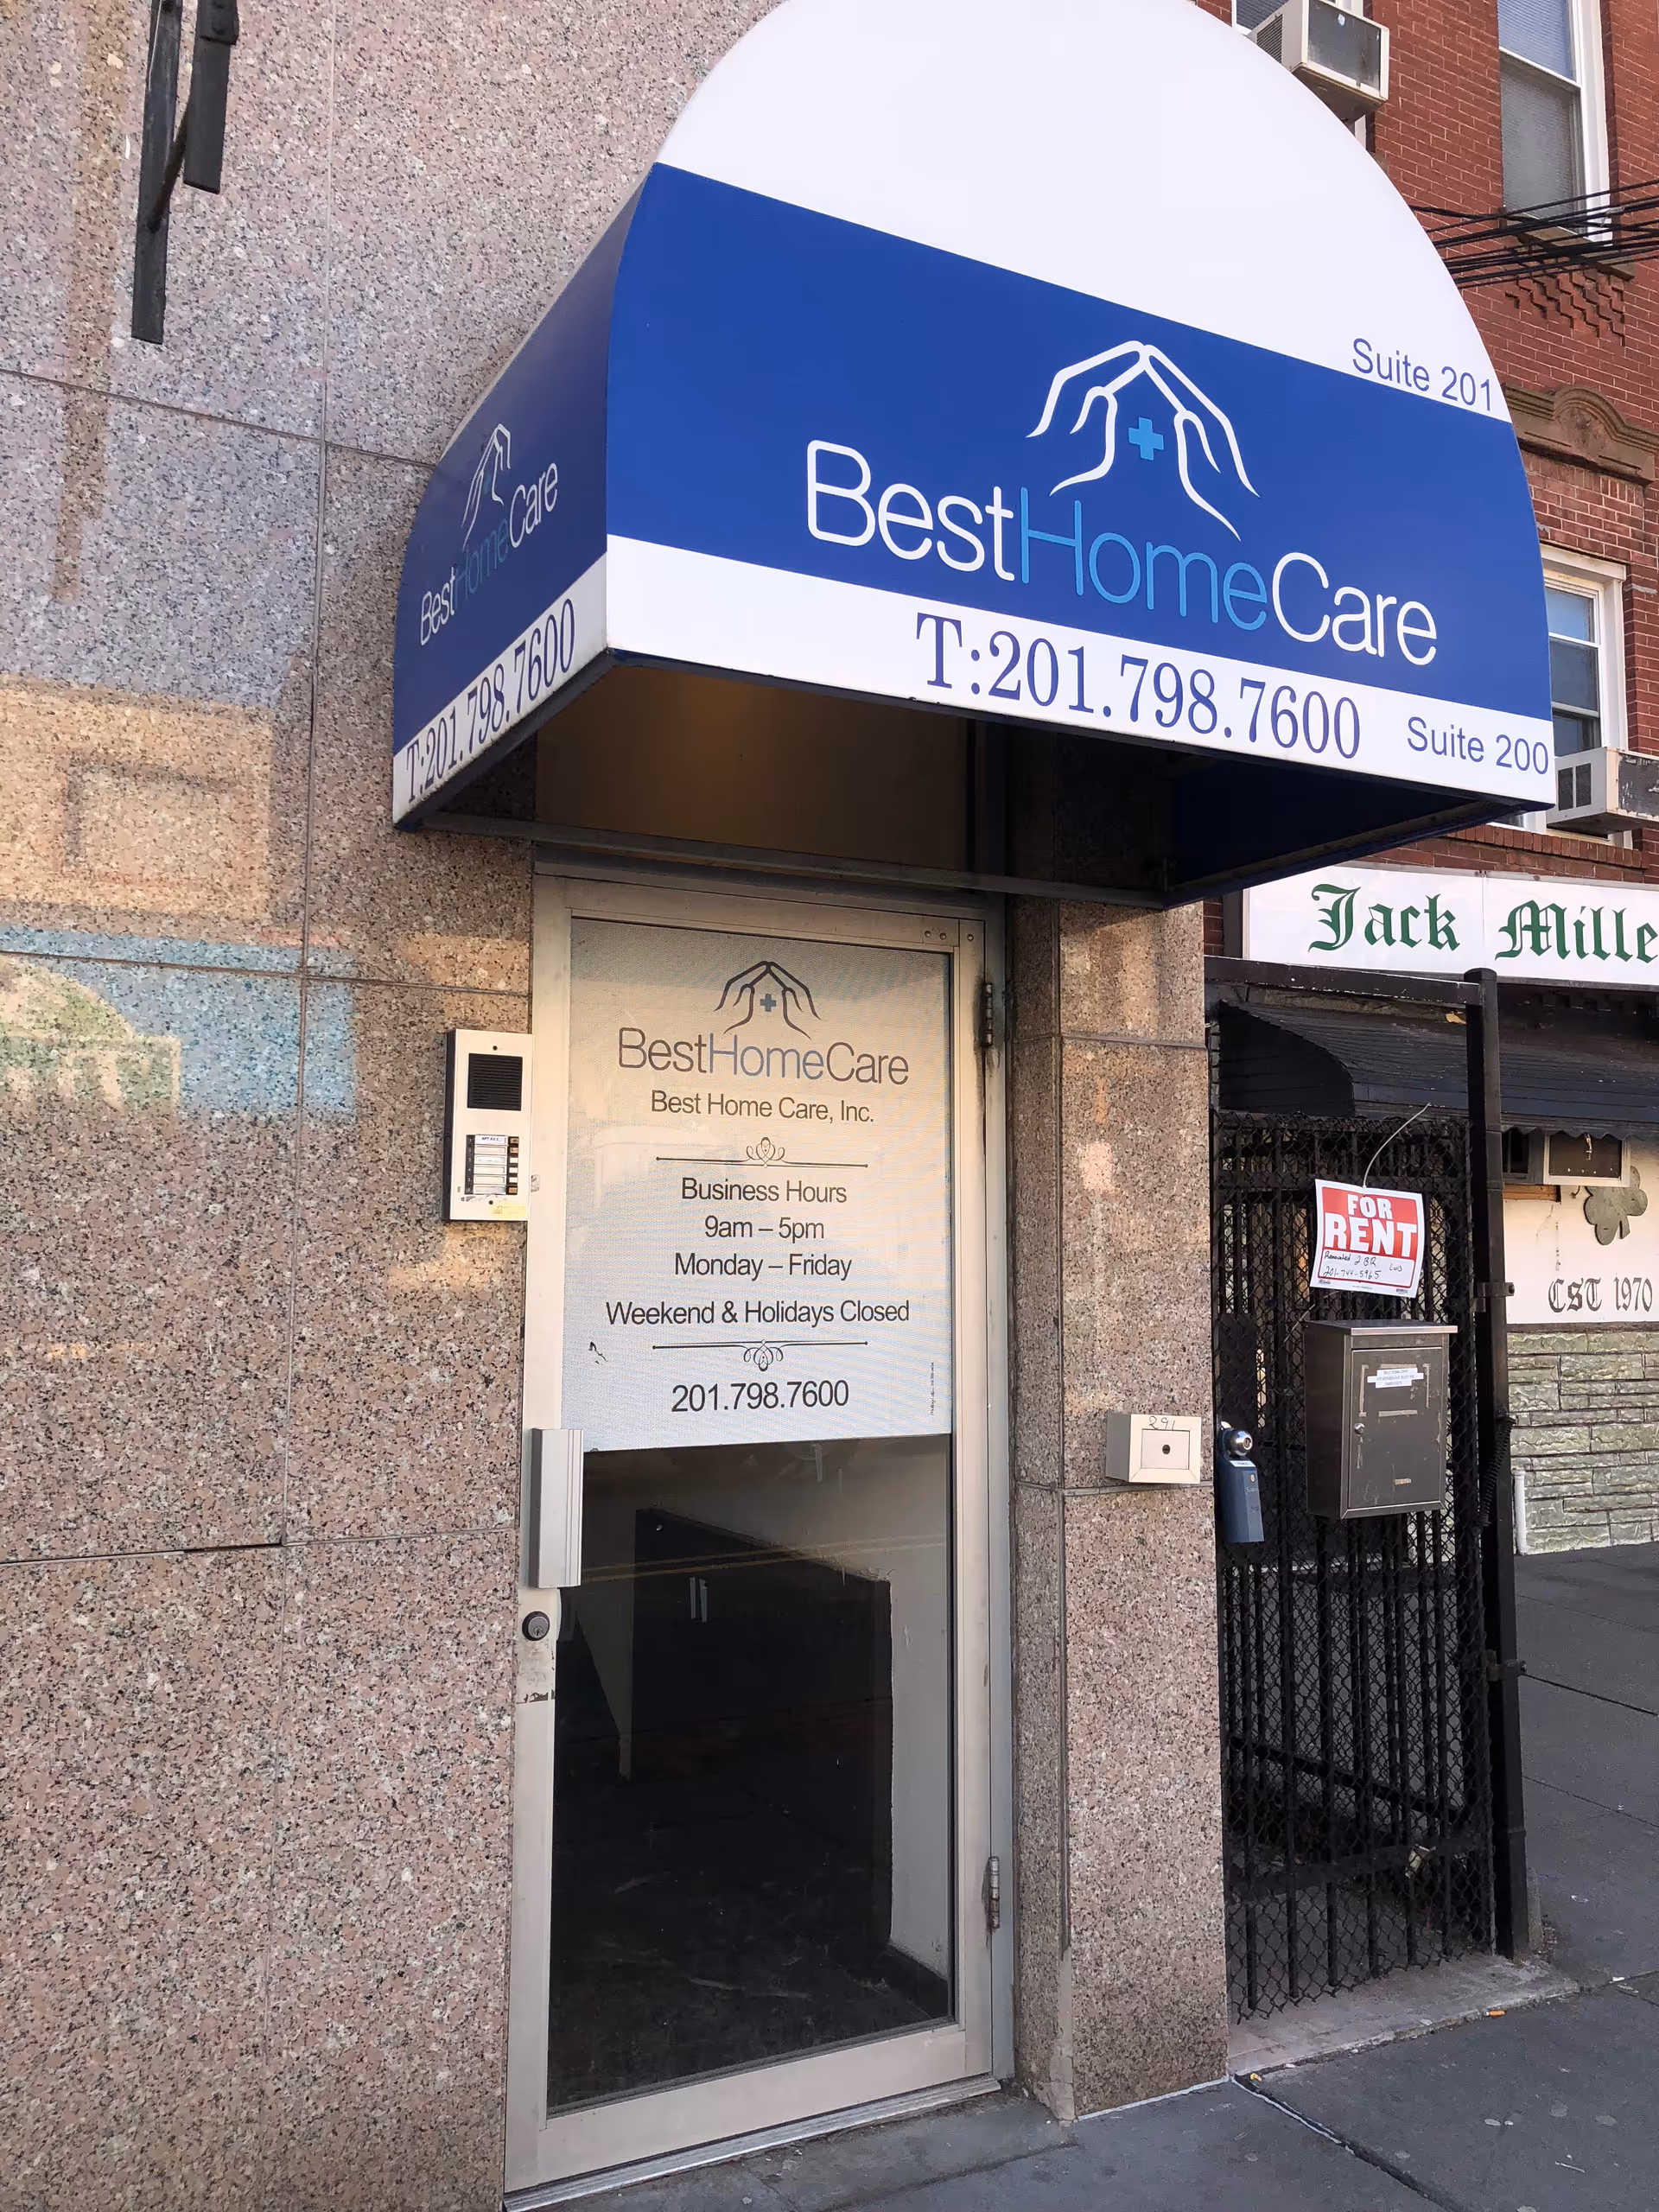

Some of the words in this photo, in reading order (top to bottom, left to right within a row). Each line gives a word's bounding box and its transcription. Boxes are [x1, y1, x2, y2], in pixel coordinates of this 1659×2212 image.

[1352, 338, 1430, 393] Suite
[1440, 366, 1492, 412] 201
[419, 461, 558, 646] BestHomeCare
[807, 439, 1438, 666] BestHomeCare
[406, 598, 575, 804] T:201.798.7600
[916, 612, 1362, 760] T:201.798.7600
[1407, 717, 1484, 764] Suite
[1496, 734, 1549, 775] 200
[1308, 884, 1460, 953] Jack
[618, 1027, 910, 1086] BestHomeCare
[652, 1090, 701, 1115] Best
[708, 1092, 773, 1119] Home
[779, 1096, 834, 1123] Care,
[840, 1099, 875, 1122] Inc.
[682, 1177, 779, 1203] Business
[786, 1179, 848, 1204] Hours
[1348, 1193, 1393, 1219] FOR
[704, 1216, 753, 1239] 9am
[779, 1217, 825, 1245] 5pm
[1324, 1211, 1417, 1257] RENT
[675, 1252, 764, 1281] Monday
[789, 1253, 853, 1282] Friday
[606, 1300, 715, 1325] Weekend
[721, 1300, 739, 1324] &
[745, 1300, 834, 1329] Holidays
[840, 1299, 910, 1323] Closed
[1612, 1276, 1653, 1313] 1970
[671, 1380, 849, 1413] 201.798.7600
